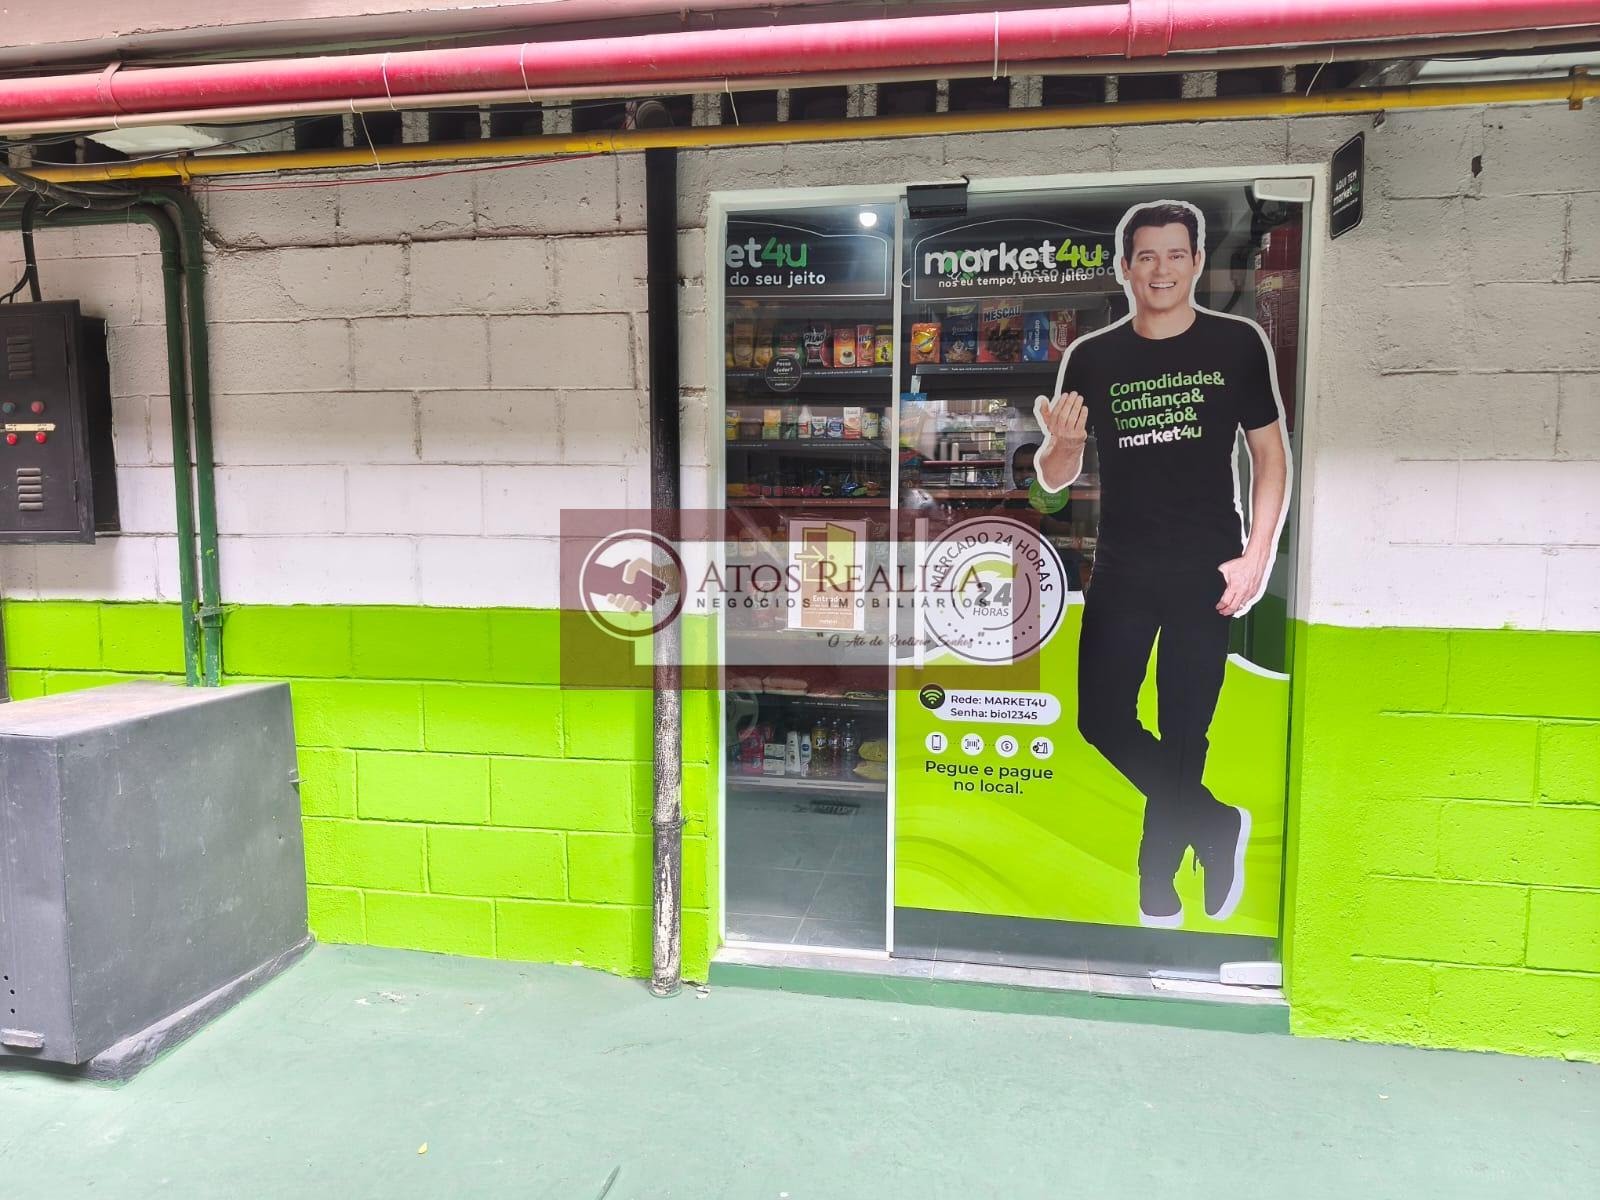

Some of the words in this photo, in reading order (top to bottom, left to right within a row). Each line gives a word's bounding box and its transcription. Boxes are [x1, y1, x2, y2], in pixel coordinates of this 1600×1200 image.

[924, 238, 1104, 275] market4u
[729, 271, 749, 286] do
[755, 274, 782, 285] seu
[787, 271, 826, 288] jeito
[976, 277, 1017, 288] tempo,
[1020, 273, 1034, 284] do
[1037, 275, 1058, 283] seu
[1060, 271, 1088, 284] jeito
[983, 305, 1021, 323] NESCAU
[1109, 370, 1225, 397] Comodidade&
[1111, 387, 1205, 414] Confiança&
[1114, 406, 1198, 431] Inovação&
[1118, 424, 1202, 449] market4u
[930, 531, 989, 588] MERCADO
[994, 532, 1013, 547] 24
[1015, 539, 1053, 593] HORAS
[974, 581, 1012, 607] 24
[972, 607, 1009, 617] HORAS
[951, 695, 982, 705] Rede:
[984, 696, 1047, 708] MARKET4U
[950, 707, 988, 718] Senha:
[990, 709, 1038, 720] bio12345
[925, 760, 979, 777] Pegue
[983, 765, 994, 776] e
[999, 766, 1054, 781] pague
[953, 780, 975, 792] no
[980, 779, 1024, 795] local.
